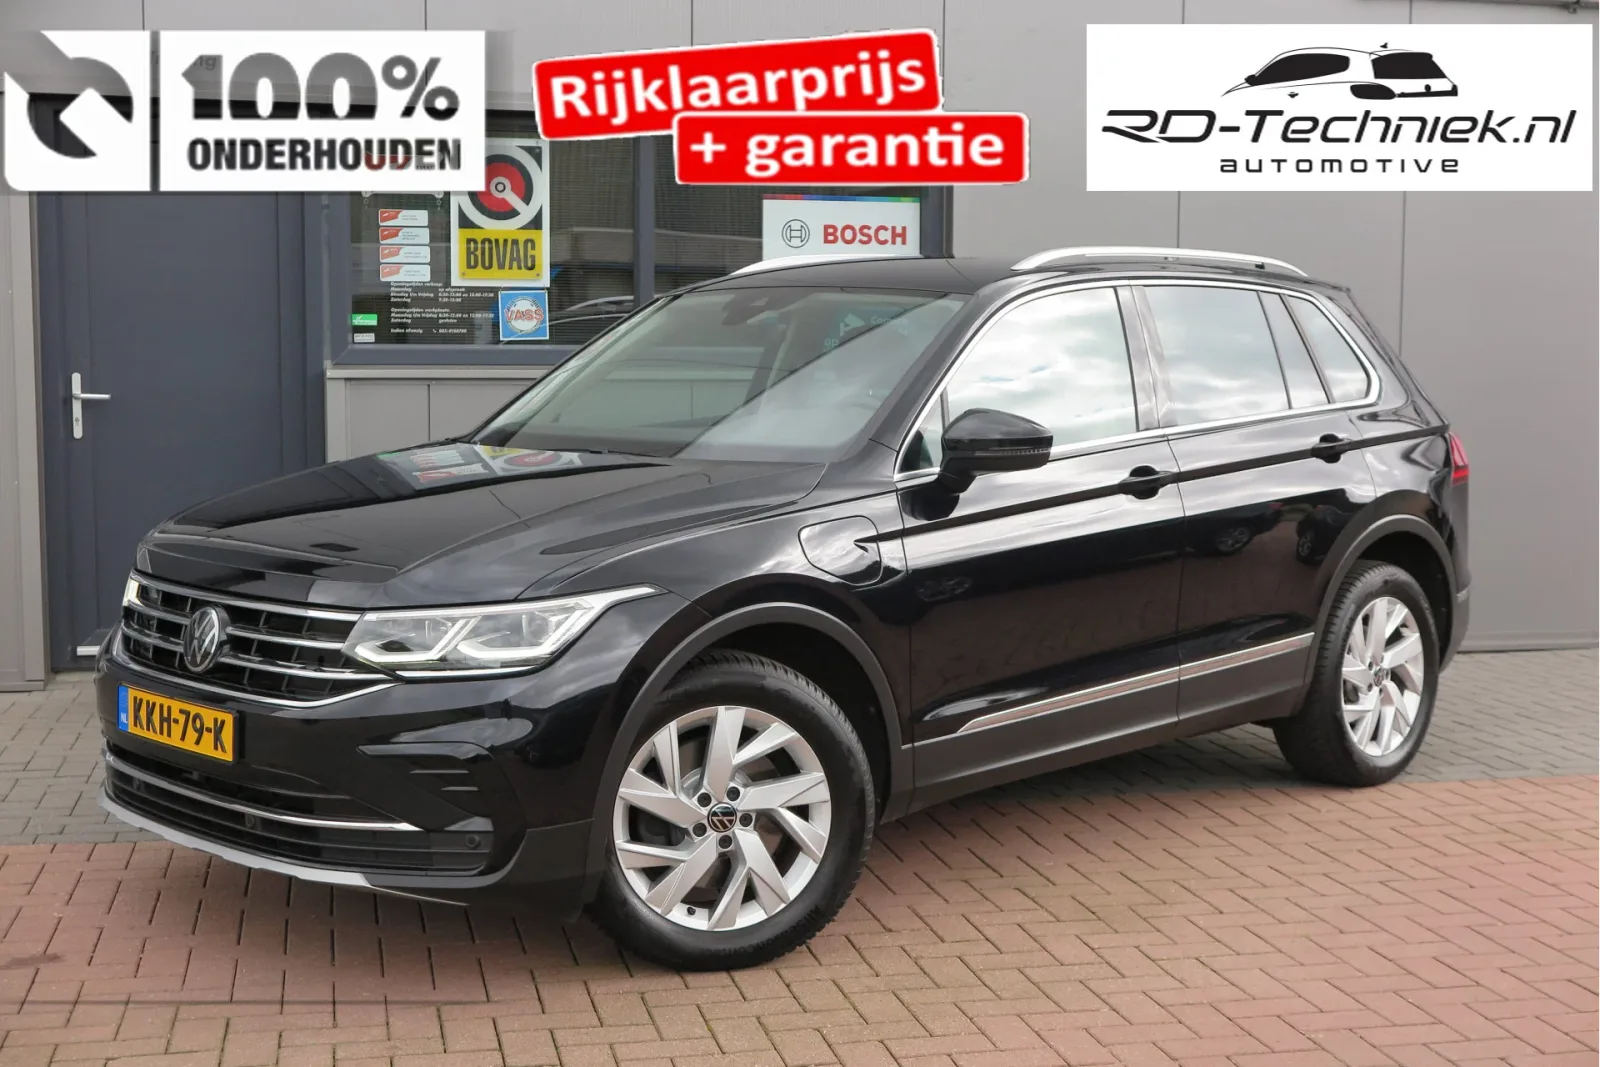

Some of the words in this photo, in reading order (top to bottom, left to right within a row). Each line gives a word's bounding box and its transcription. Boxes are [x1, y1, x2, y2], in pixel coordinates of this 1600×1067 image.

[823, 224, 907, 246] BOSCH
[465, 237, 536, 271] BOVAG
[504, 308, 544, 321] VASS
[133, 695, 227, 754] KKH-79-K
